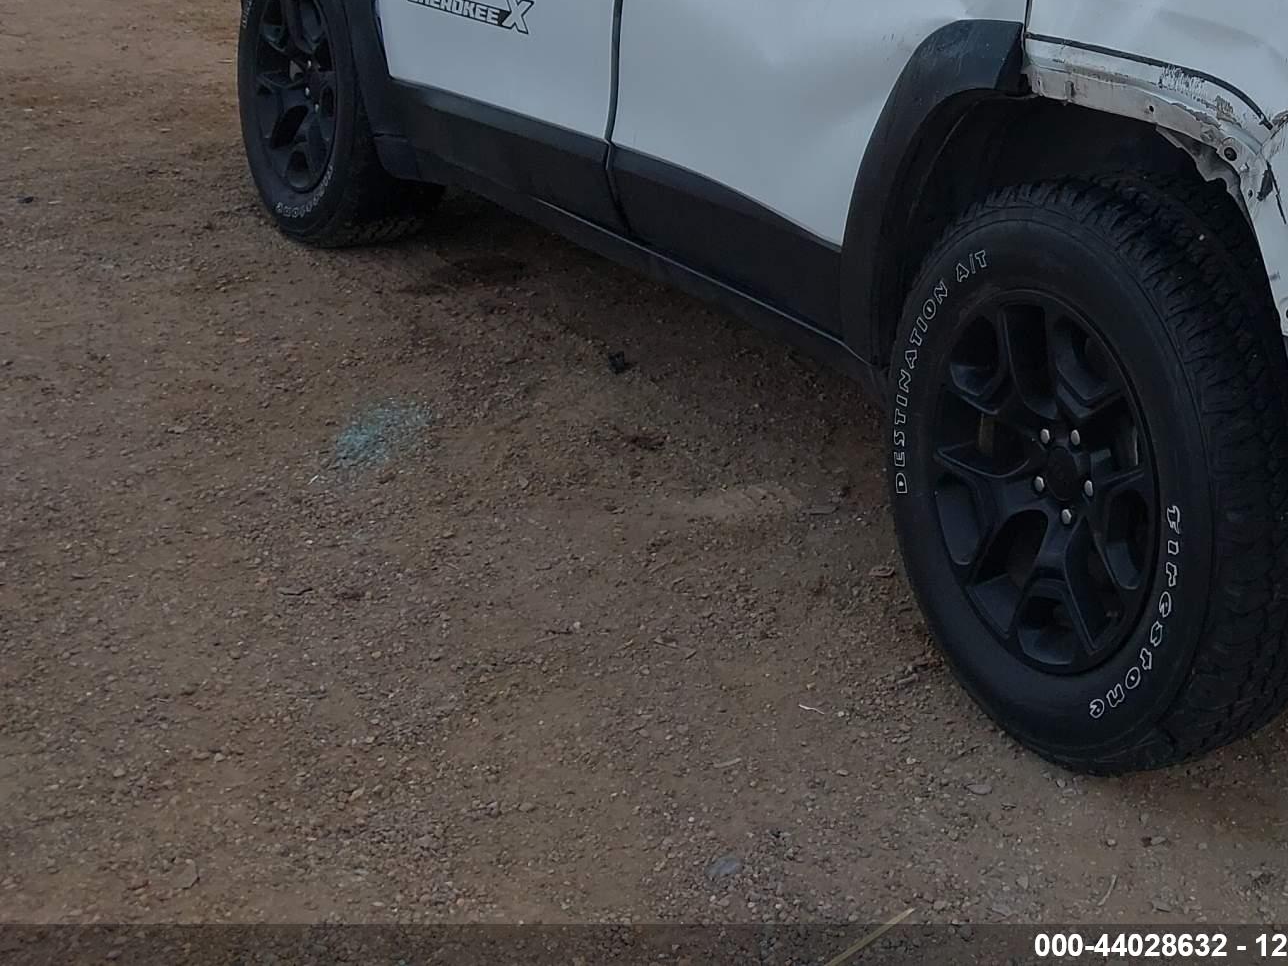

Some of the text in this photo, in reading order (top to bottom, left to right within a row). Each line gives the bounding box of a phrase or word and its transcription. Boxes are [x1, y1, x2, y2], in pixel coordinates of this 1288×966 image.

[893, 249, 988, 494] DESTINATION A/T
[1089, 505, 1181, 719] Firestone
